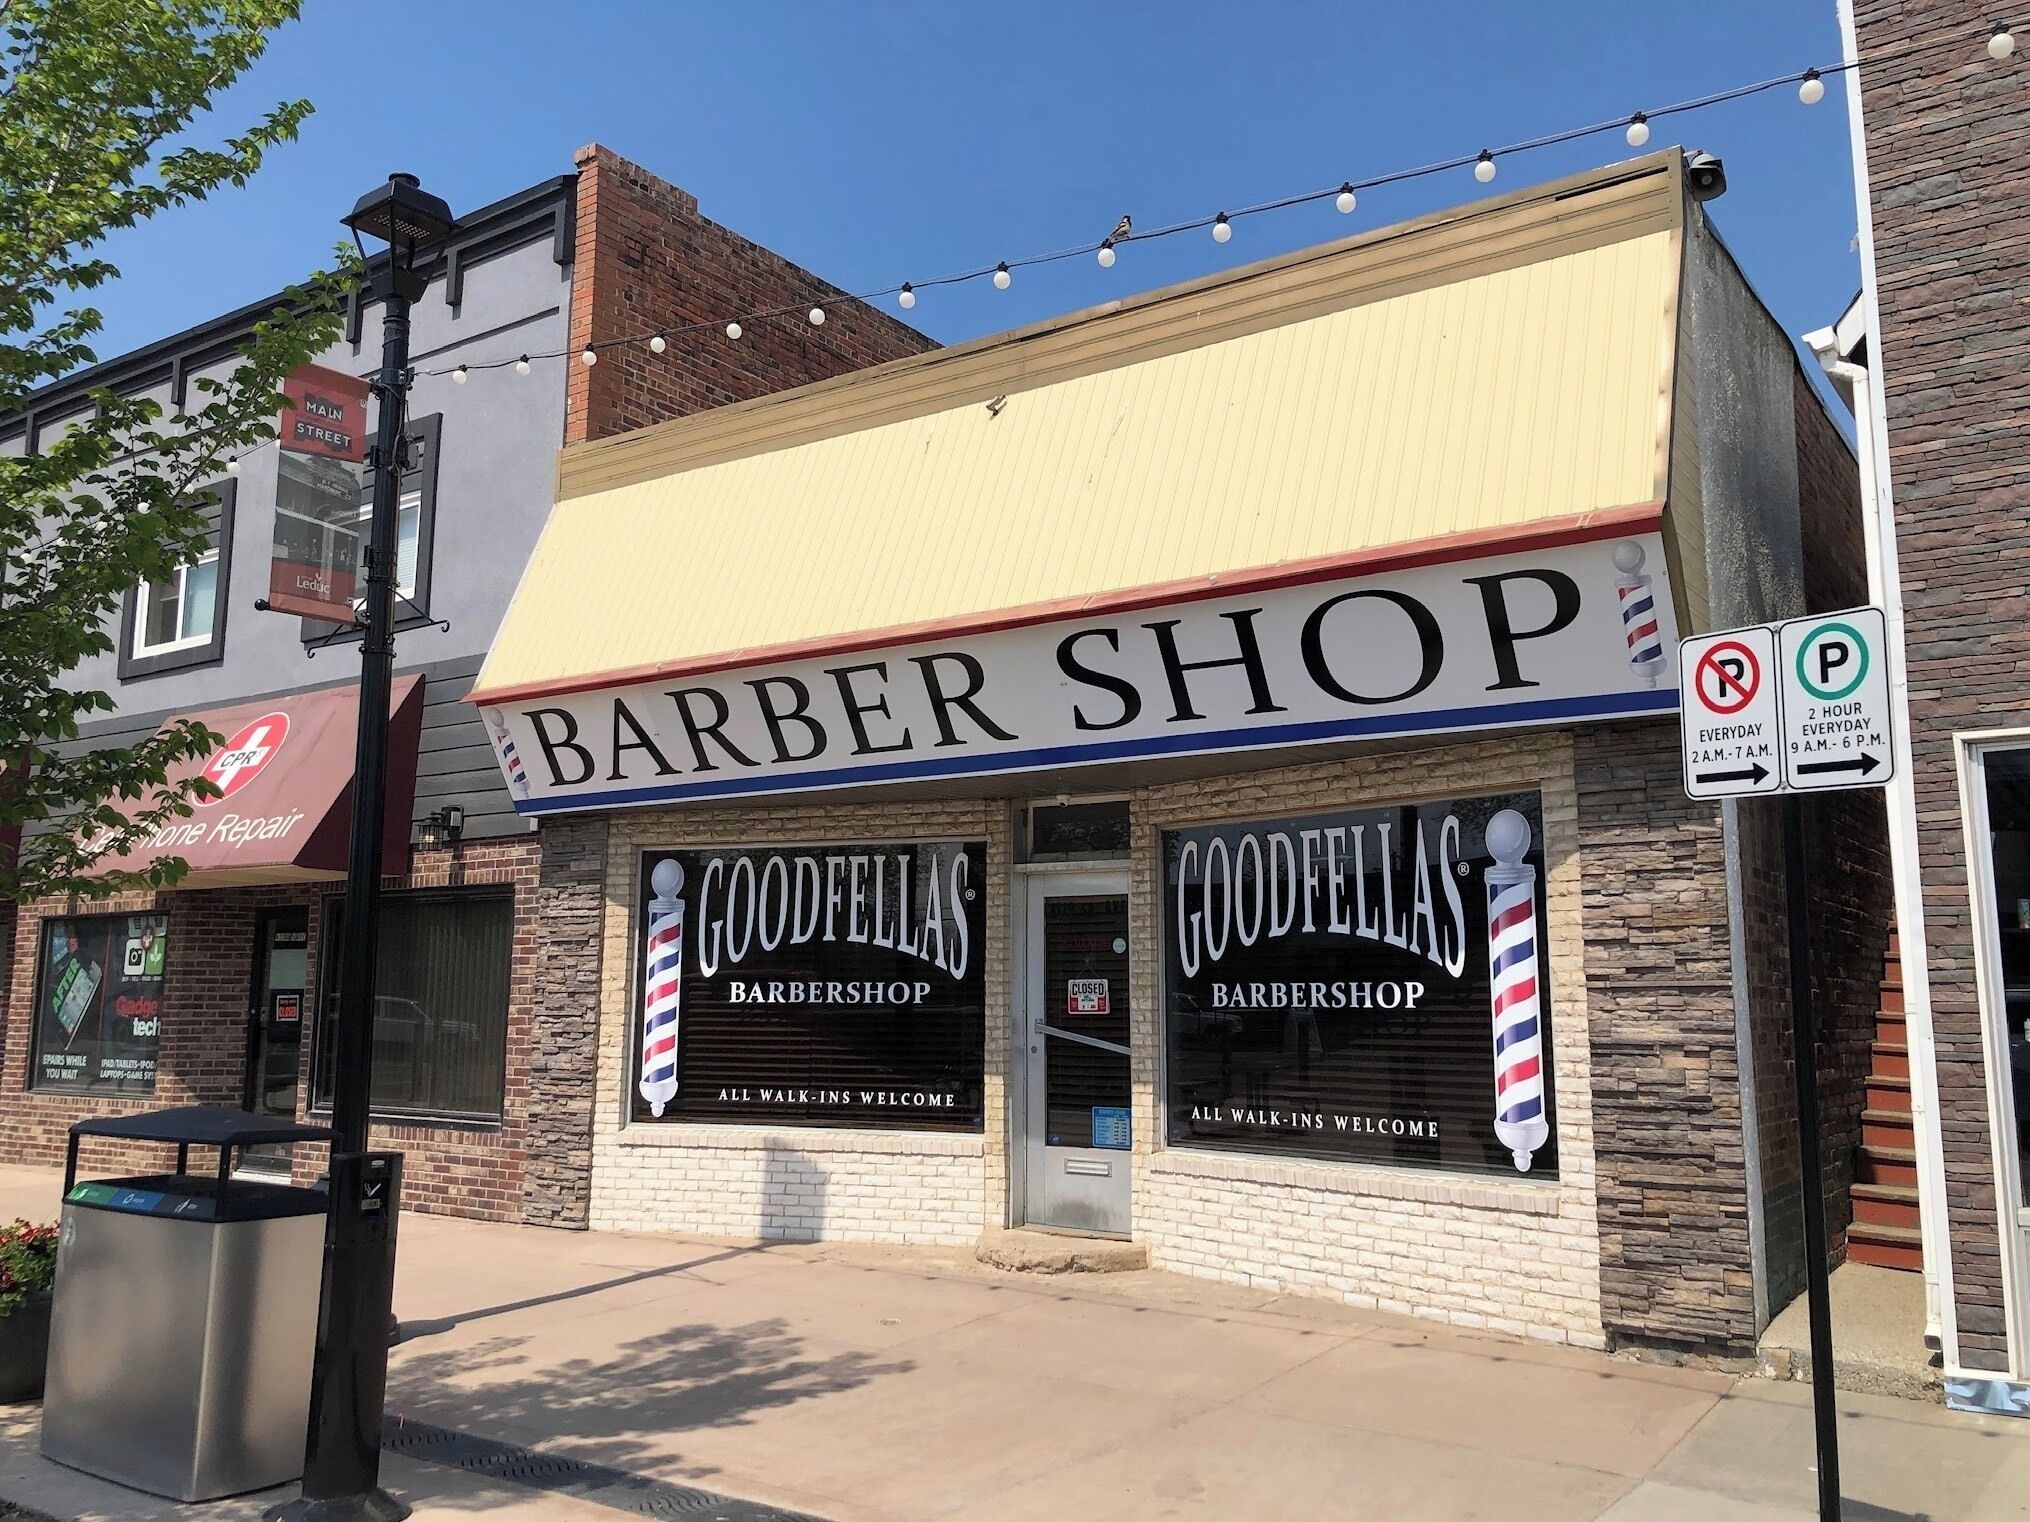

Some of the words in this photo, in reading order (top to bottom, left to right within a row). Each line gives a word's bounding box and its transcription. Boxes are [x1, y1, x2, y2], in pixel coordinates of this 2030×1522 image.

[306, 400, 343, 422] MAIN
[296, 423, 352, 448] STREET
[296, 575, 331, 594] Leduc
[1818, 641, 1849, 684] P
[522, 651, 1019, 788] BARBER
[1056, 568, 1582, 731] SHOP
[1808, 707, 1816, 720] 2
[1822, 702, 1862, 718] HOUR
[1699, 723, 1763, 743] EVERYDAY
[1802, 717, 1871, 737] EVERYDAY
[1691, 751, 1699, 764] 2
[1735, 746, 1742, 759] 7
[1746, 744, 1773, 758] A.M.
[1790, 742, 1799, 754] 9
[1842, 736, 1850, 749] 6
[1857, 733, 1886, 747] P.M.
[220, 751, 258, 768] CPR
[206, 808, 304, 849] Repair
[52, 957, 80, 1015] AFTER
[728, 981, 931, 1004] BARBERSHOP
[1072, 982, 1104, 996] CLOSED
[1211, 981, 1425, 1009] BARBERSHOP
[132, 1016, 162, 1037] tech
[65, 1055, 88, 1067] WHILE
[46, 1068, 60, 1079] YOU
[61, 1069, 79, 1080] WAIT
[718, 1088, 751, 1102] ALL
[760, 1089, 851, 1104] WALK-INS
[860, 1091, 955, 1107] WELCOME
[1192, 1105, 1223, 1121] ALL
[1231, 1108, 1324, 1130] WALK-INS
[1333, 1114, 1439, 1138] WELCOME
